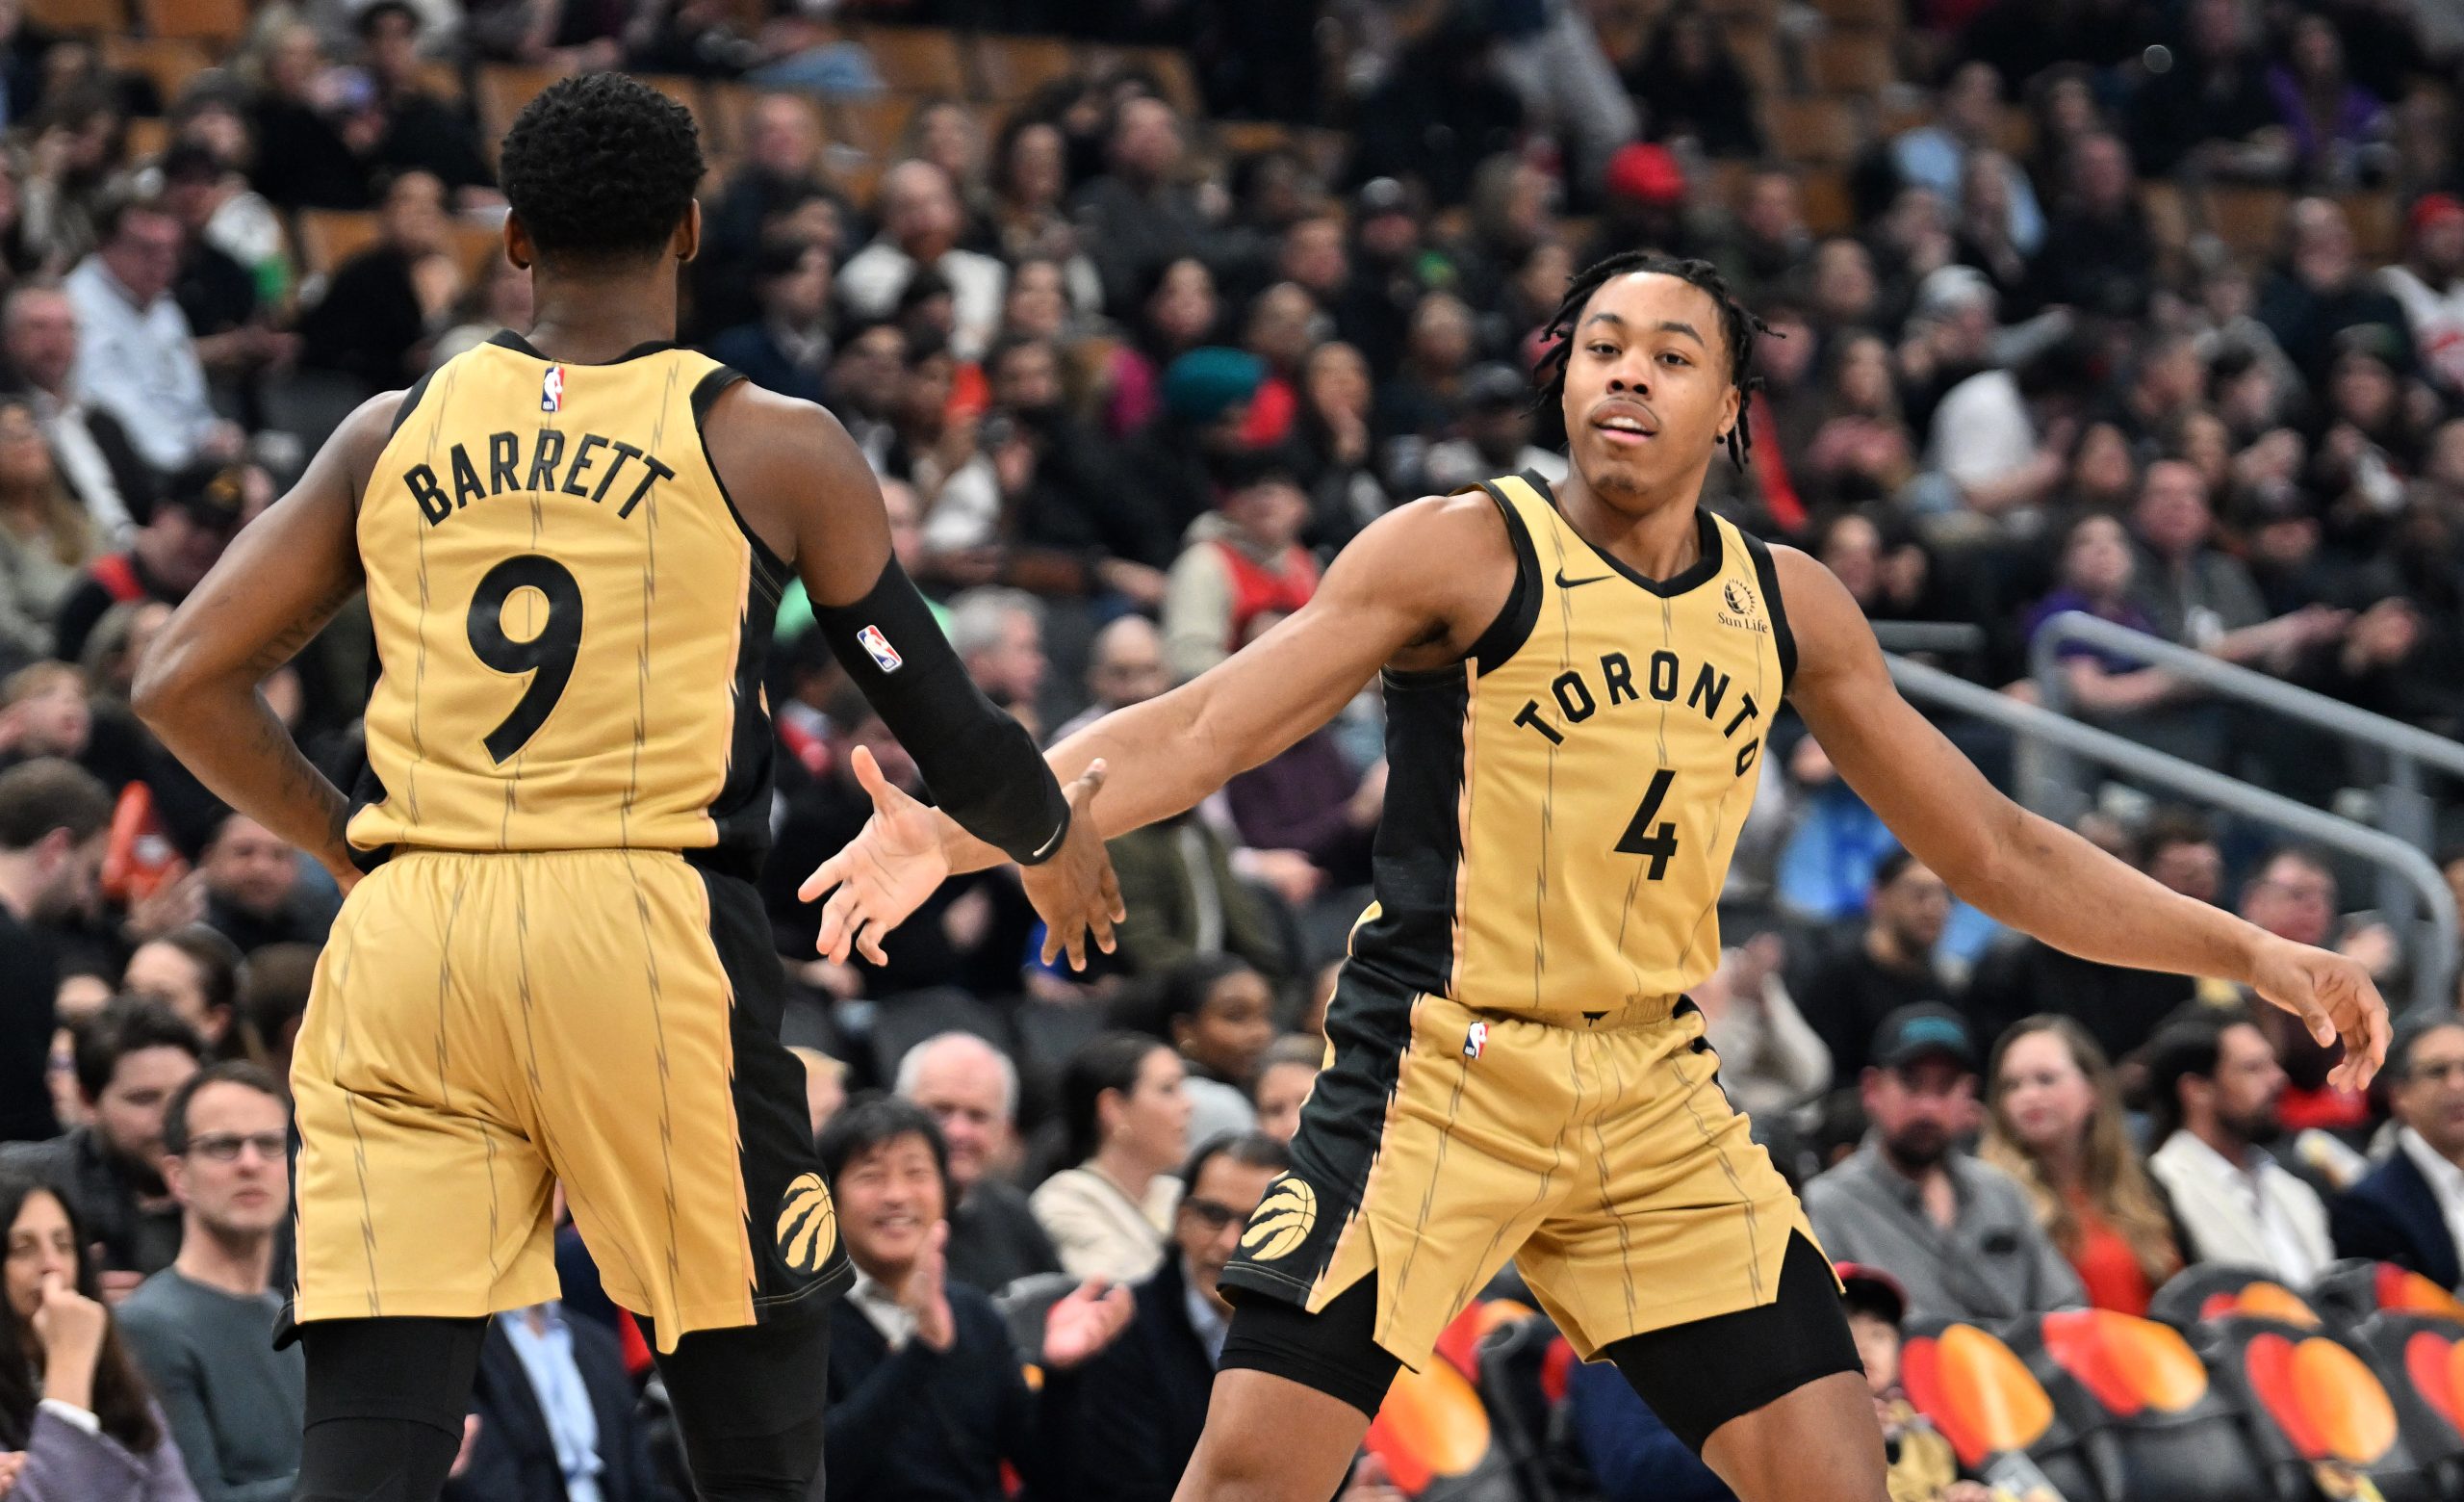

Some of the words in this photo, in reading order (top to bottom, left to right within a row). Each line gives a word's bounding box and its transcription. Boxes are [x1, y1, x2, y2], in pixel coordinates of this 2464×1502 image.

[402, 427, 677, 528] BARRETT
[466, 553, 584, 766] 9
[1717, 610, 1742, 628] Sun
[1745, 617, 1768, 634] Life
[1512, 649, 1759, 778] TORONTO
[1612, 767, 1679, 881] 4
